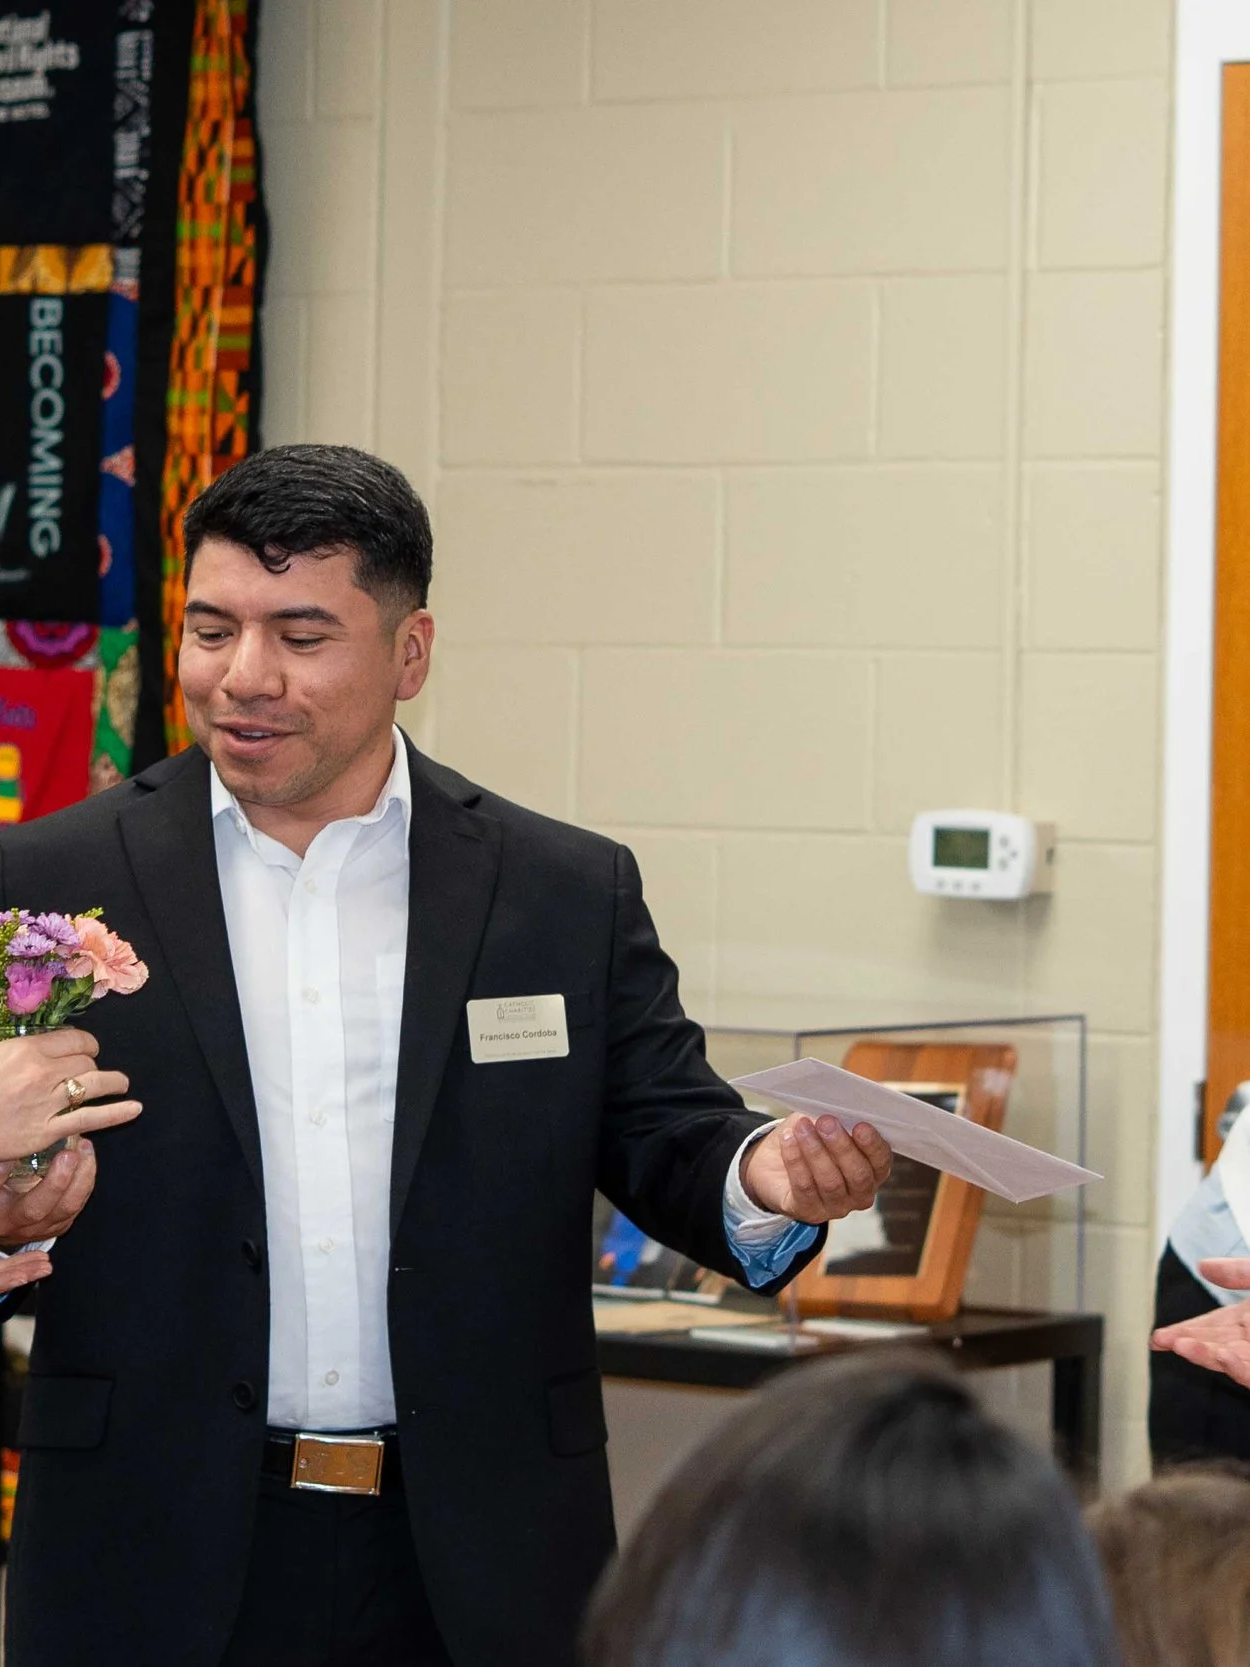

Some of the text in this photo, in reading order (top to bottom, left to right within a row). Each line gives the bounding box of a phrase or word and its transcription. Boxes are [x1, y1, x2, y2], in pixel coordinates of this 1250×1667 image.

[29, 298, 64, 558] BECOMING
[479, 1029, 557, 1042] Francisco Cordoba
